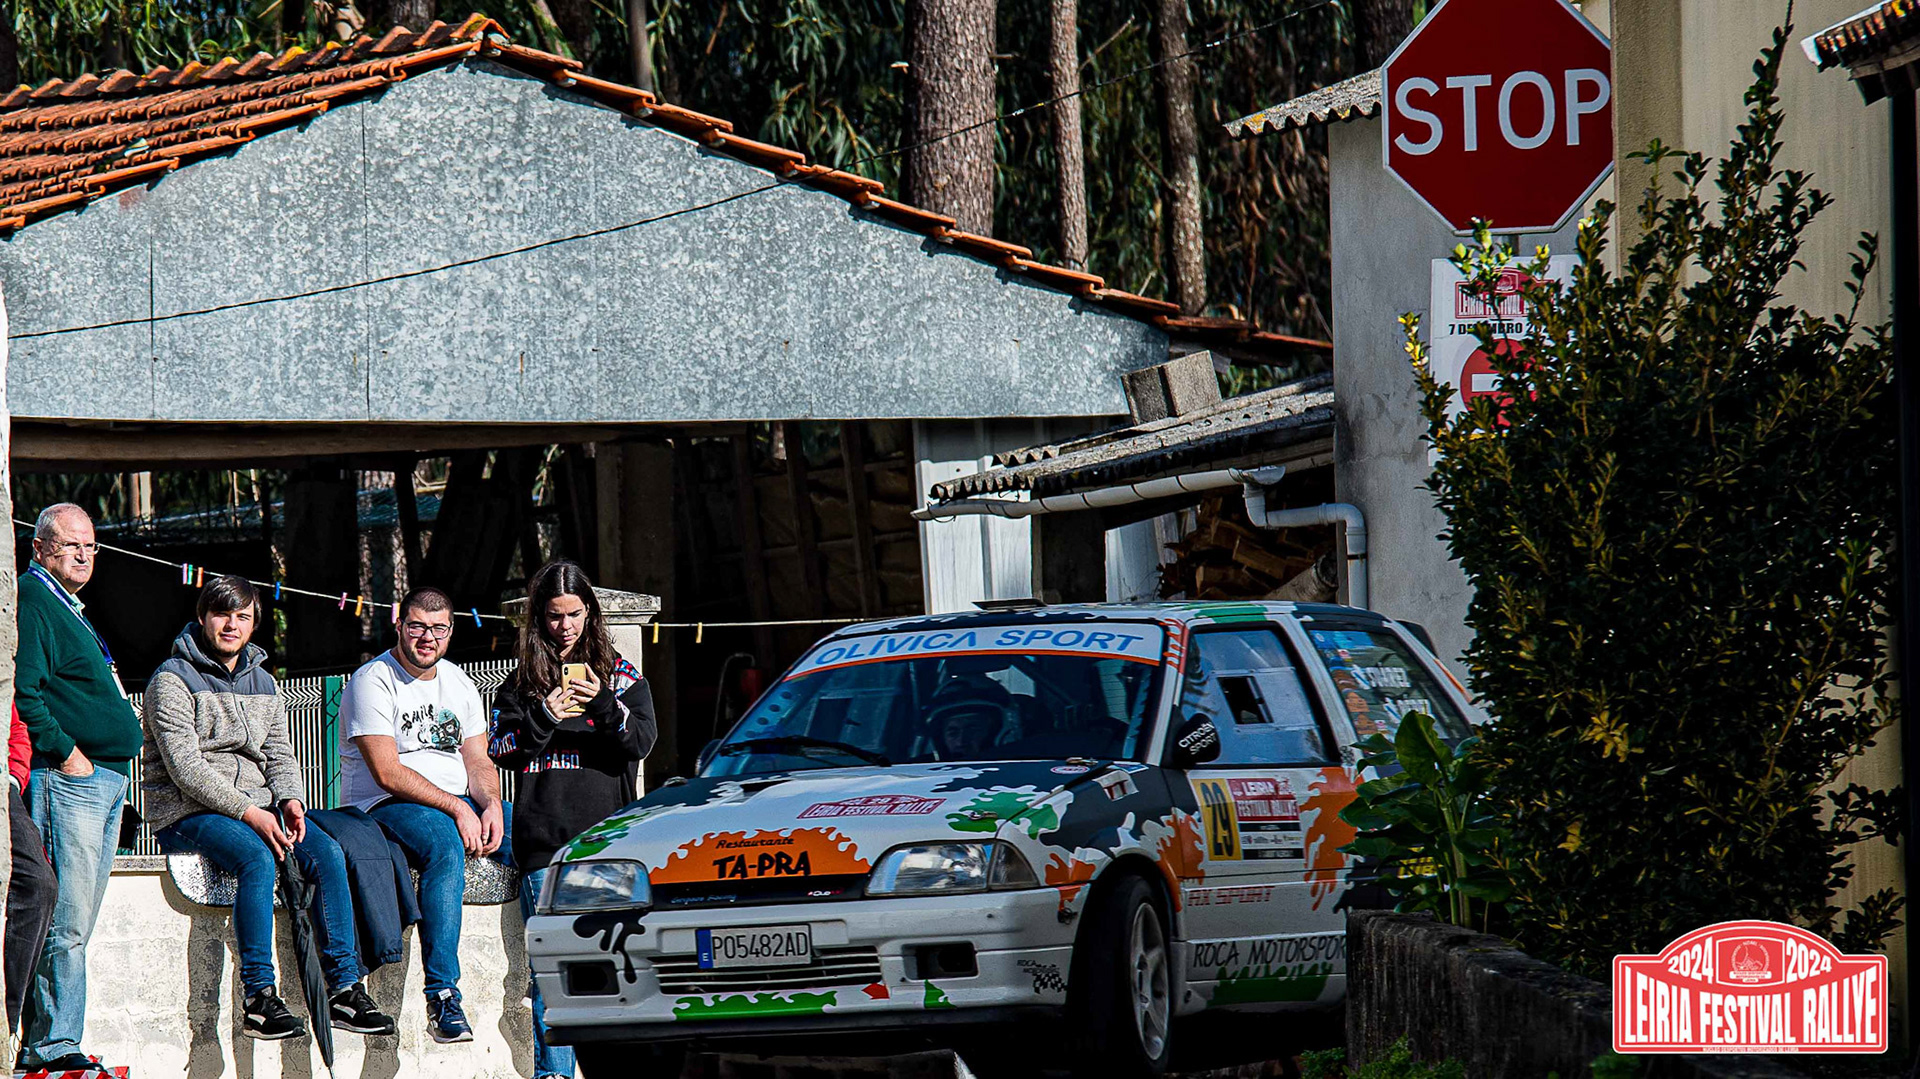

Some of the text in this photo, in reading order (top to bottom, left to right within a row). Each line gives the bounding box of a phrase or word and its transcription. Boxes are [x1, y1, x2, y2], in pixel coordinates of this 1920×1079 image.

[1394, 68, 1611, 155] STOP
[1449, 323, 1456, 335] 7
[995, 630, 1144, 651] SPORT
[803, 804, 844, 818] LEIRIA
[840, 804, 890, 816] FESTIVAL
[891, 800, 941, 814] RALLYE
[1201, 782, 1234, 857] 29
[716, 837, 795, 849] Restaurante
[712, 851, 811, 879] TA-PRA
[702, 952, 709, 961] E
[1193, 940, 1240, 968] ROCA
